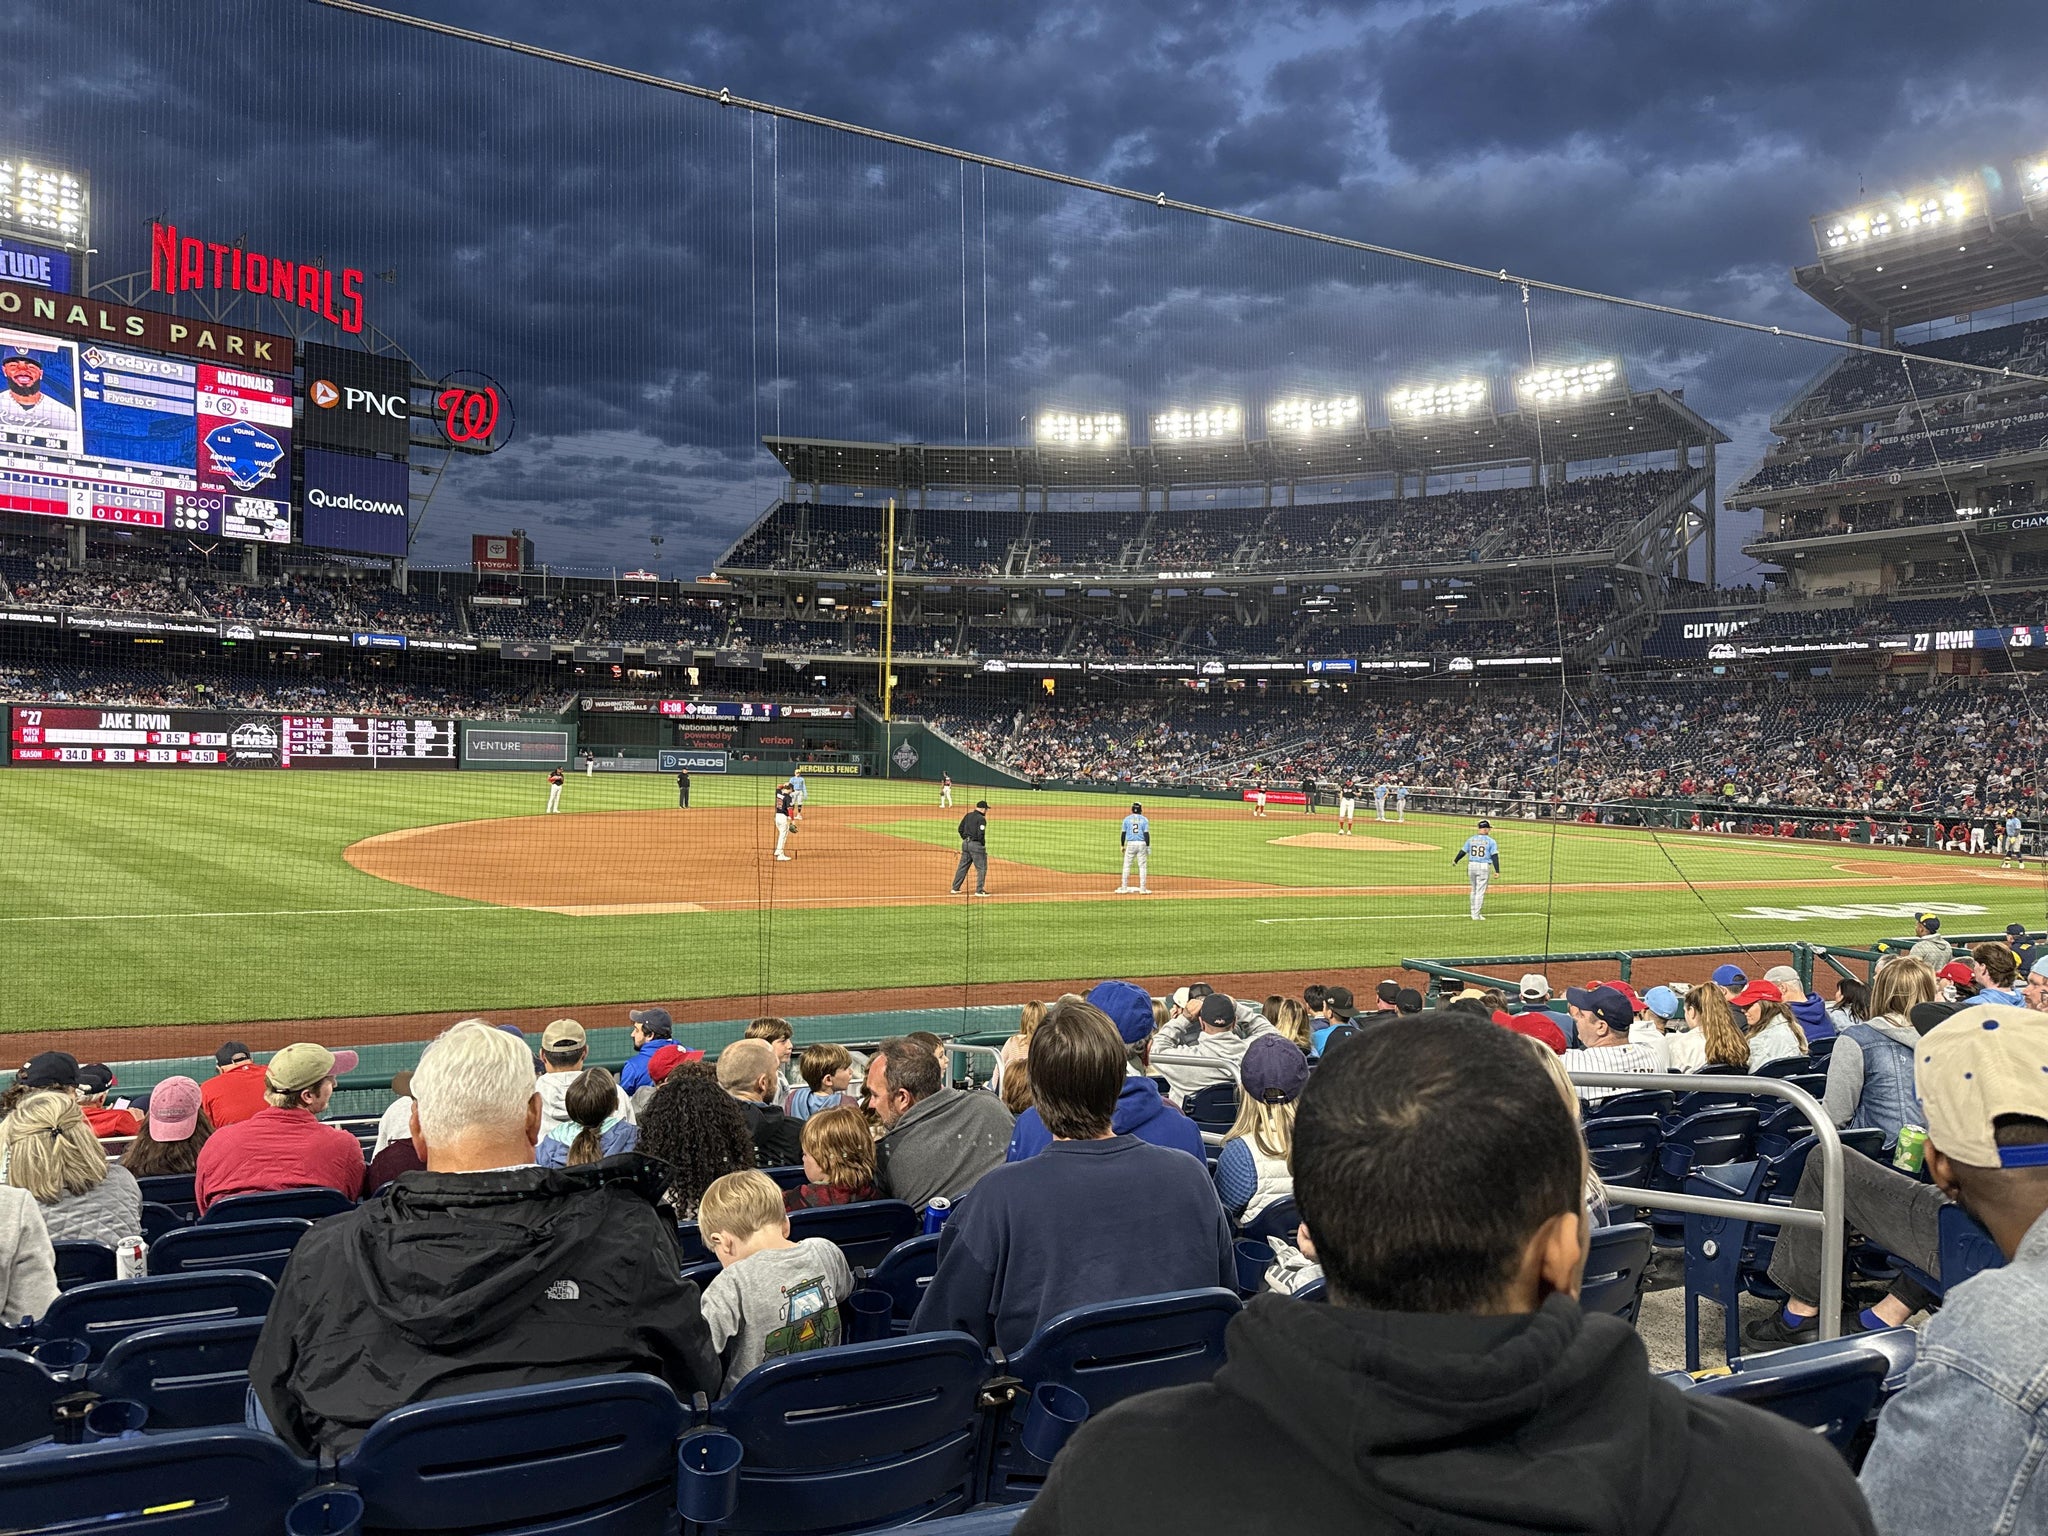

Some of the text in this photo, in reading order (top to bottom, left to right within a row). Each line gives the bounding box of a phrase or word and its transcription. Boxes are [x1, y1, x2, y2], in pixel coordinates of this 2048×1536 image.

[152, 222, 364, 334] NATIONALS
[169, 323, 273, 361] PARK
[105, 353, 184, 377] Today: 0-1
[106, 375, 120, 385] BB
[217, 370, 274, 393] NATIONALS
[106, 392, 157, 408] Flyout to CF
[217, 387, 239, 396] IRVIN
[271, 396, 287, 404] RHP
[204, 400, 249, 415] 37 92 55
[344, 387, 407, 419] PNC
[438, 386, 500, 443] W
[233, 427, 255, 437] YOUNG
[1879, 436, 1899, 445] NEED
[1900, 427, 1950, 443] ASSISTANCE?
[1950, 425, 1970, 434] TEXT
[2000, 417, 2011, 426] TO
[217, 435, 231, 444] LILE
[254, 441, 275, 450] WOOD
[210, 453, 236, 463] ABRAMS
[211, 465, 233, 473] HOUSE
[254, 460, 272, 468] VIVAS
[258, 471, 276, 479] HEAD
[1891, 474, 1899, 483] 11
[77, 492, 84, 501] 2
[97, 494, 105, 504] 5
[114, 496, 123, 506] 0
[132, 498, 142, 508] 4
[175, 495, 184, 505] B
[240, 498, 276, 512] STAR
[308, 488, 405, 516] Qualcomm
[76, 506, 84, 516] 0
[96, 508, 105, 518] 0
[114, 510, 123, 520] 0
[132, 512, 142, 522] 4
[175, 506, 184, 517] S
[234, 503, 279, 520] WARS
[1980, 523, 2008, 532] FIS
[67, 616, 217, 633] Protecting Your Home from Uninvited Pests
[1913, 629, 1974, 652] 27 IRVIN
[2009, 633, 2032, 646] 4.50
[1740, 641, 1869, 655] Protecting Your Home from Uninvited Pests
[594, 700, 635, 708] WASHINGTON
[613, 703, 648, 712] NATIONALS
[662, 702, 682, 713] 8:08
[764, 708, 770, 717] 9
[793, 707, 831, 715] WASHINGTON
[20, 709, 171, 730] #27 JAKE IRVIN
[22, 728, 40, 736] PITCH
[678, 723, 739, 732] Nationals Park
[23, 735, 39, 743] DATA
[166, 733, 185, 744] 8.5"
[231, 733, 278, 747] PMSI
[684, 731, 733, 742] powered by
[759, 736, 794, 745] verizon
[472, 741, 521, 751] VENTURE
[693, 740, 725, 749] Verizon
[19, 750, 43, 758] SEASON
[65, 749, 87, 760] 34.0
[113, 750, 126, 760] 39
[157, 751, 170, 760] 1-3
[195, 751, 215, 762] 4.50
[851, 754, 860, 763] 335
[678, 758, 724, 767] DABOS
[799, 764, 859, 774] HERCULES FENCE
[1132, 823, 1139, 834] 2
[1470, 845, 1486, 858] 68
